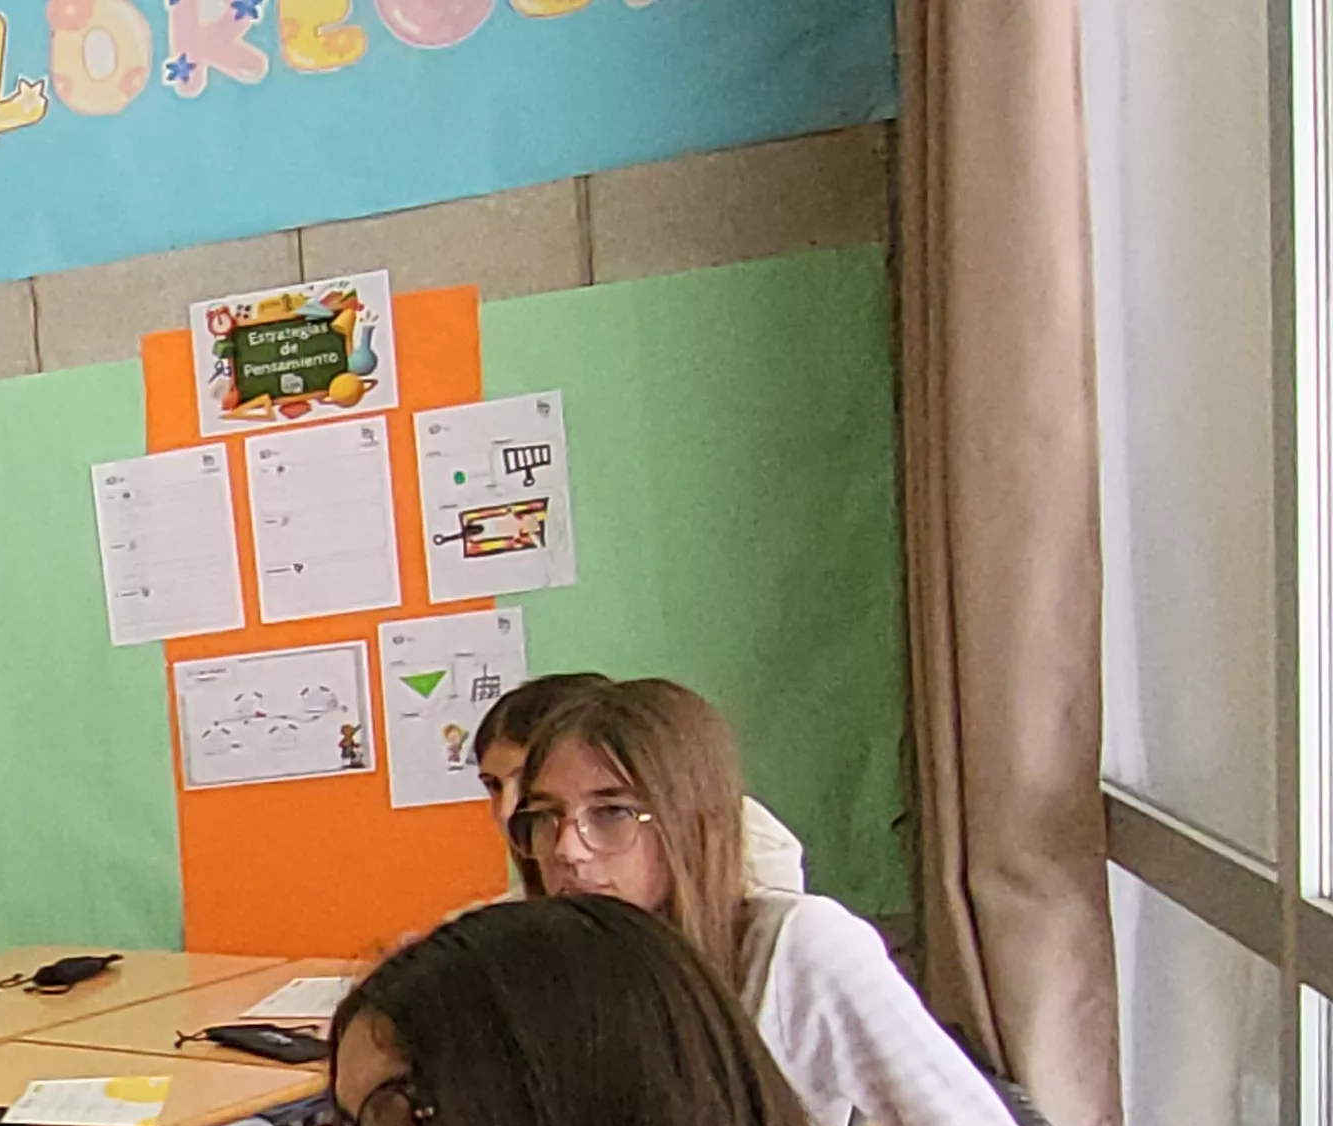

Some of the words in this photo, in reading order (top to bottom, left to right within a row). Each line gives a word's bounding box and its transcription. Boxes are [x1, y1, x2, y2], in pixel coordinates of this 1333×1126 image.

[247, 321, 330, 347] Estrategias
[280, 341, 299, 356] de
[243, 352, 339, 378] Pensamiento
